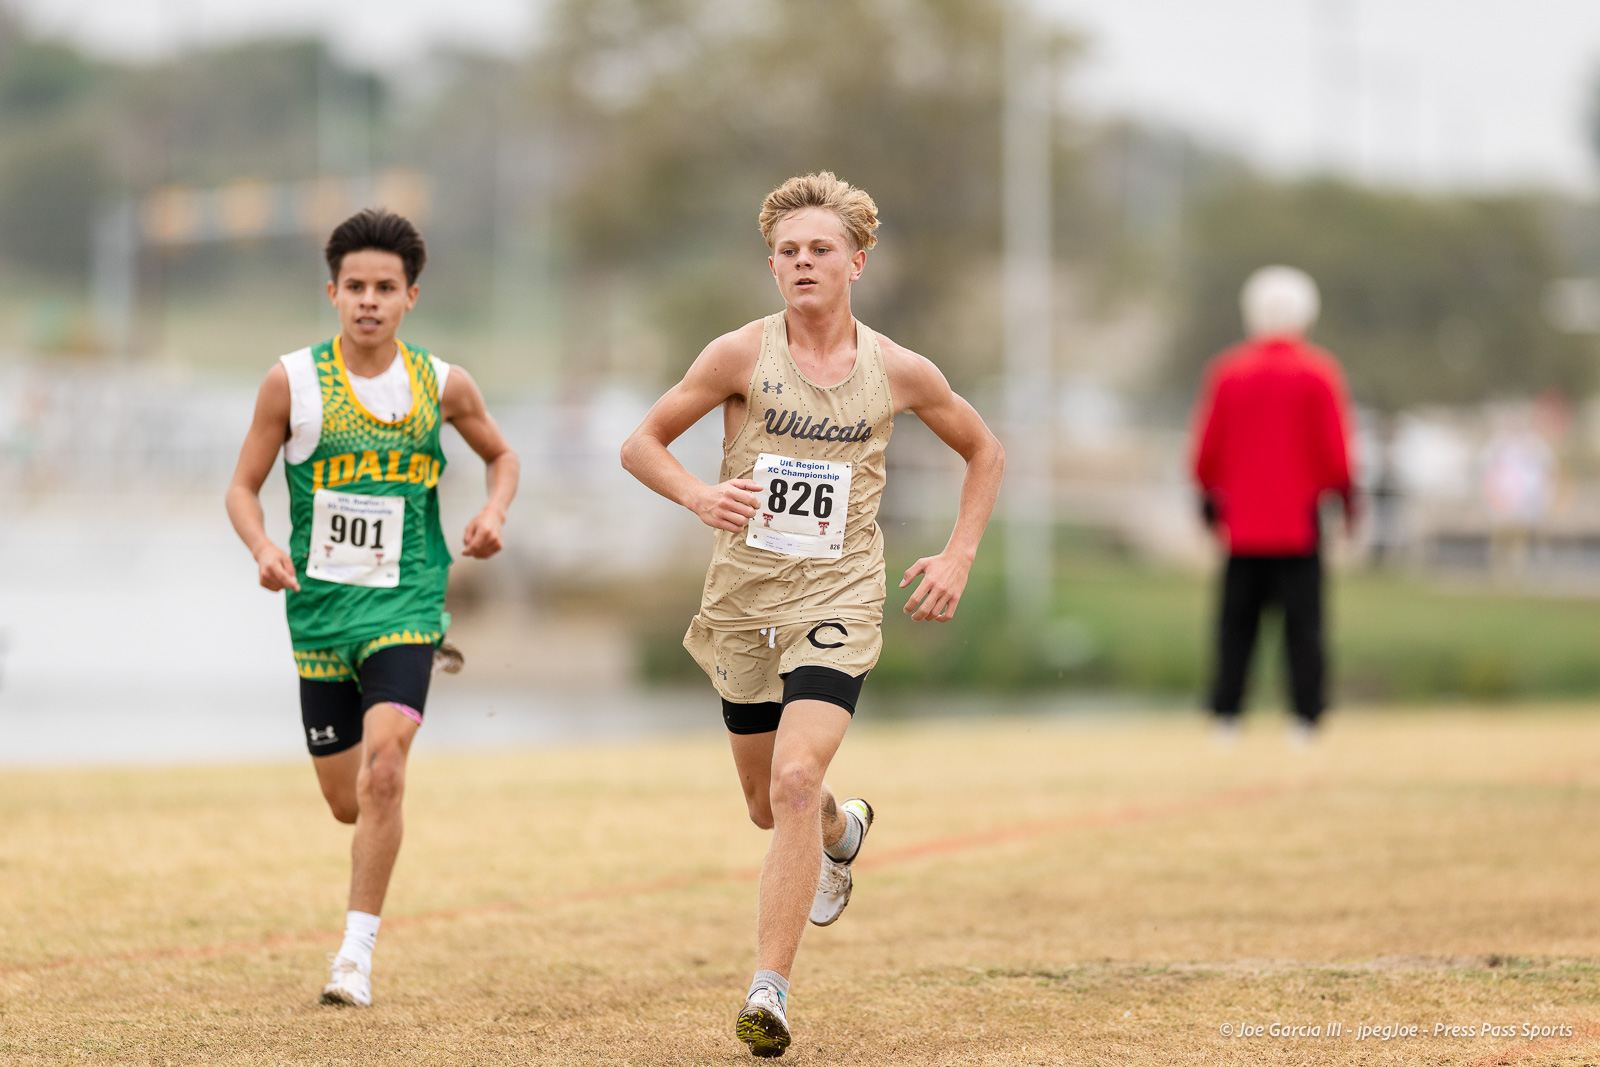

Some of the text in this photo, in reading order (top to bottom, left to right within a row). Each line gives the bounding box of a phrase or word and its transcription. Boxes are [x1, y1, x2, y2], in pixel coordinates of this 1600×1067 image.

[764, 408, 873, 443] Wildcats
[311, 450, 440, 493] IDALOU
[767, 466, 840, 481] XC Championship
[780, 459, 794, 467] UIL
[796, 461, 825, 470] Region
[767, 478, 834, 518] 826
[330, 514, 384, 549] 901
[806, 622, 848, 649] C
